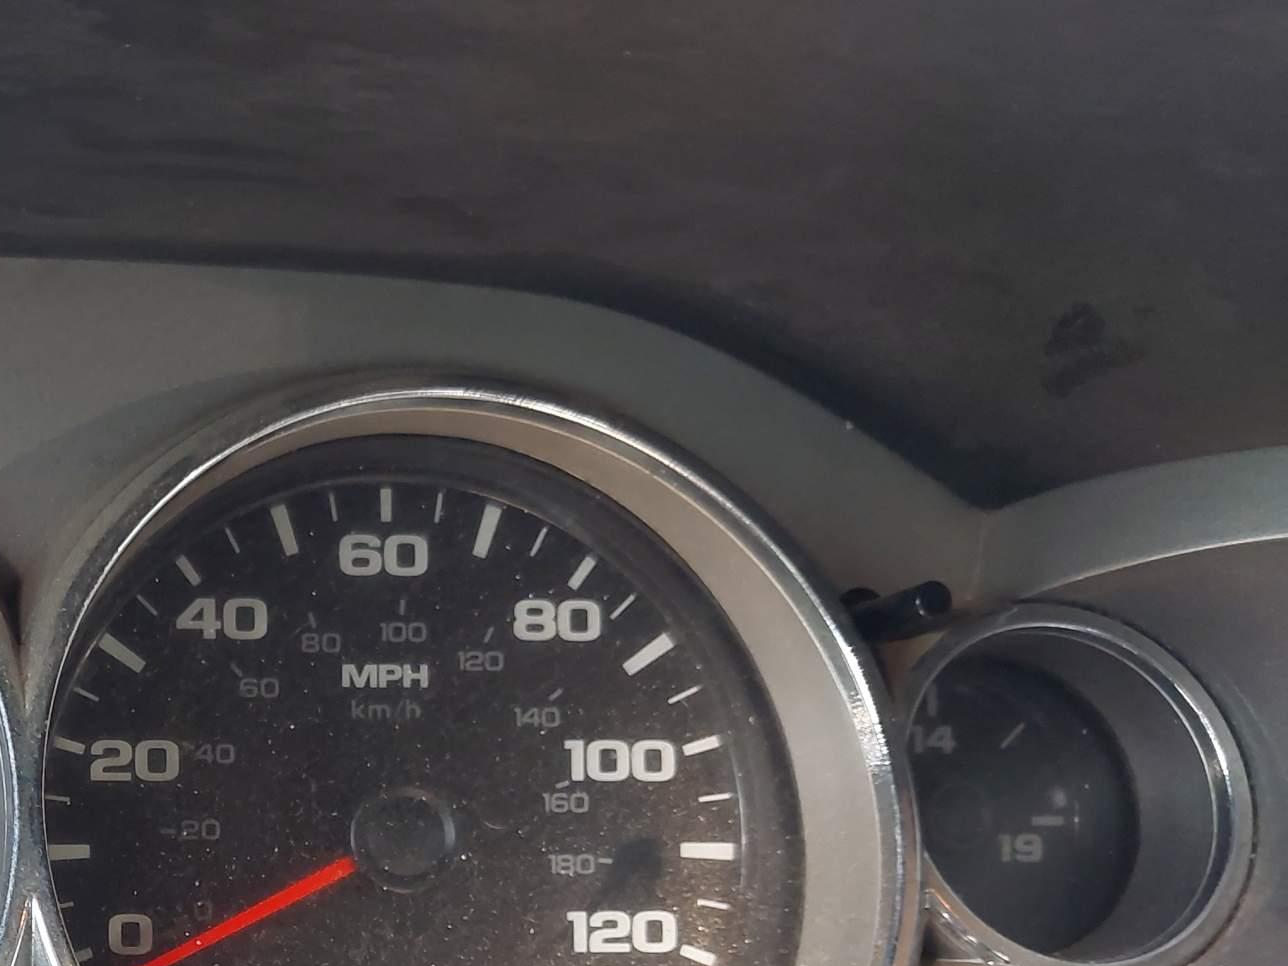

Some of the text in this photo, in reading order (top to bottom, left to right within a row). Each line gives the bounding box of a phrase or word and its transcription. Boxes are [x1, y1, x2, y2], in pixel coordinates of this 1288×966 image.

[339, 535, 429, 576] 60
[175, 598, 268, 640] 40
[513, 599, 601, 642] 80
[301, 632, 341, 652] 80
[380, 621, 426, 642] 100
[458, 651, 504, 671] 120
[341, 664, 428, 688] MPH
[239, 677, 280, 697] 60
[351, 699, 421, 719] km/h
[514, 707, 560, 728] 140
[89, 741, 181, 782] 20
[193, 744, 234, 764] 40
[565, 741, 676, 782] 100
[543, 792, 589, 813] 160
[181, 821, 220, 840] 20
[998, 833, 1043, 863] 19
[550, 854, 594, 875] 180
[108, 914, 152, 955] 0
[568, 912, 678, 953] 120
